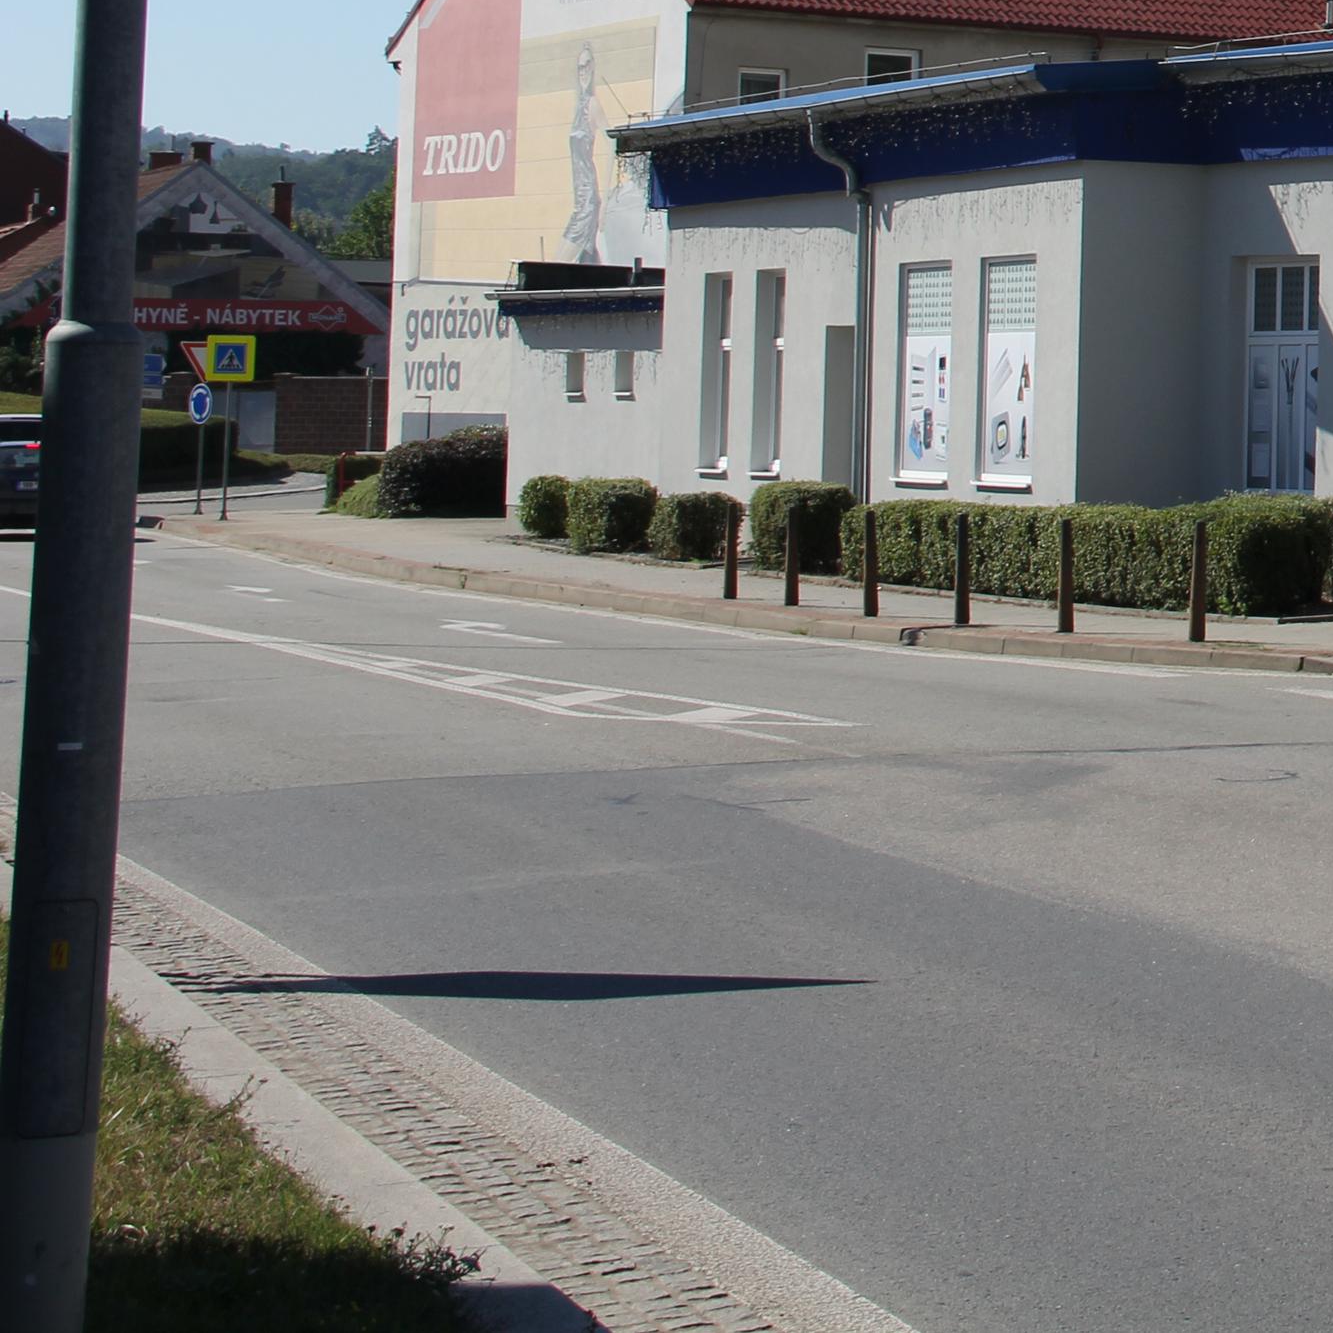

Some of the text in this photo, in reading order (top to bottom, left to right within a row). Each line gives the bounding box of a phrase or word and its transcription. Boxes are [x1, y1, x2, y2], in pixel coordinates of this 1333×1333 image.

[422, 129, 507, 176] TRIDO
[133, 303, 188, 324] HYNĚ
[206, 304, 301, 326] NÁBYTEK
[404, 352, 462, 391] vrata
